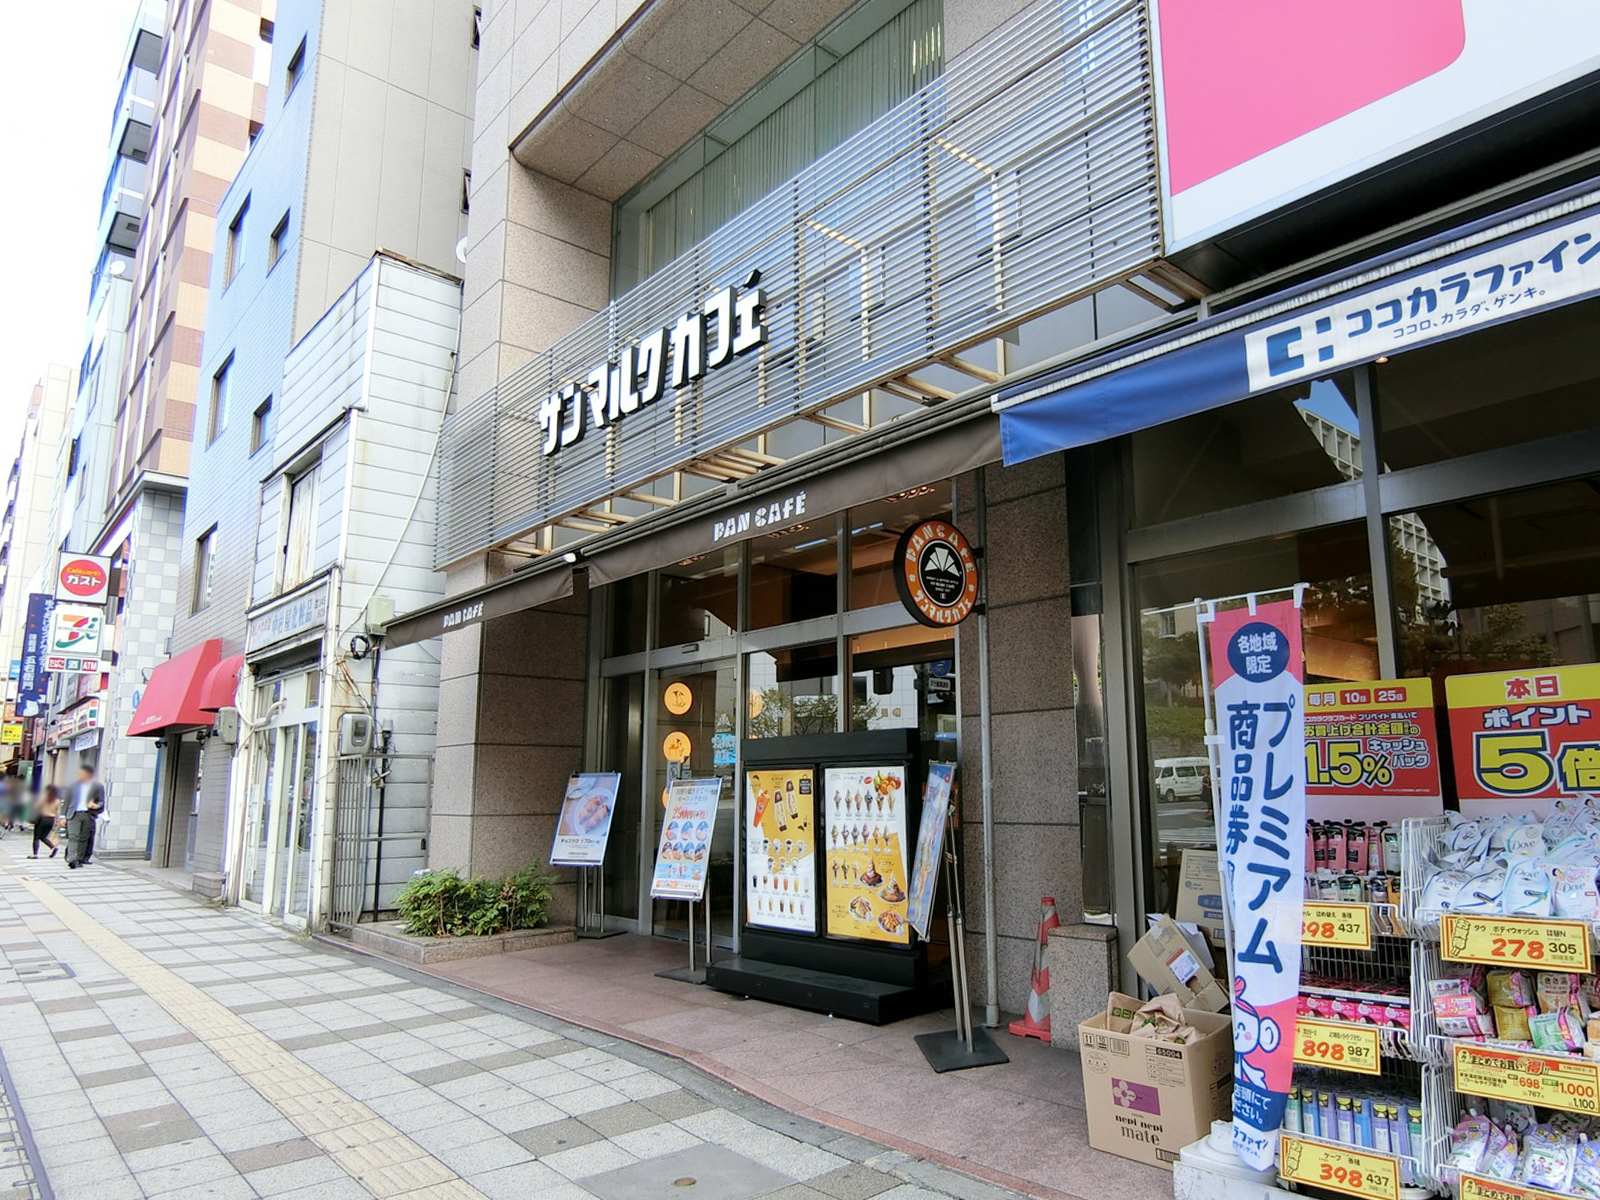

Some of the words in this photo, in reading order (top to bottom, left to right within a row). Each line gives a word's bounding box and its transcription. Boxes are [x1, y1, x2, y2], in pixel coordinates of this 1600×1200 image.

[1346, 233, 1600, 338] ココカラファイン
[1393, 286, 1546, 340] ココロ、カラダ、ゲンキ。
[539, 269, 768, 456] サンマルクカフェ
[712, 512, 750, 542] PAN
[754, 490, 807, 528] CAFÉ
[66, 574, 102, 587] ガスト
[442, 610, 462, 628] PAN
[1237, 631, 1278, 654] 各地域
[82, 660, 99, 672] ATM
[1246, 654, 1273, 675] 限定
[1504, 676, 1560, 699] 本日
[1308, 692, 1336, 706] 毎月
[1344, 692, 1367, 703] 10日
[1378, 690, 1404, 702] 25日
[1483, 703, 1592, 729] ポイント
[1367, 739, 1428, 753] キャッシュ
[1304, 740, 1393, 786] 1.5%
[1391, 753, 1430, 768] バック
[1237, 693, 1296, 974] プレミアム
[1512, 839, 1536, 850] Dove
[1513, 868, 1540, 878] Dove
[1563, 882, 1586, 893] Dove
[1338, 923, 1361, 933] 437
[1491, 938, 1544, 960] 278
[1548, 942, 1577, 955] 305
[1302, 1040, 1345, 1061] 898
[1347, 1045, 1370, 1057] 987
[1519, 1076, 1540, 1089] 698
[1115, 1114, 1137, 1126] nepi
[1140, 1119, 1163, 1133] nepi
[1121, 1126, 1160, 1146] mate
[1319, 1163, 1363, 1188] 398
[1366, 1173, 1389, 1187] 437
